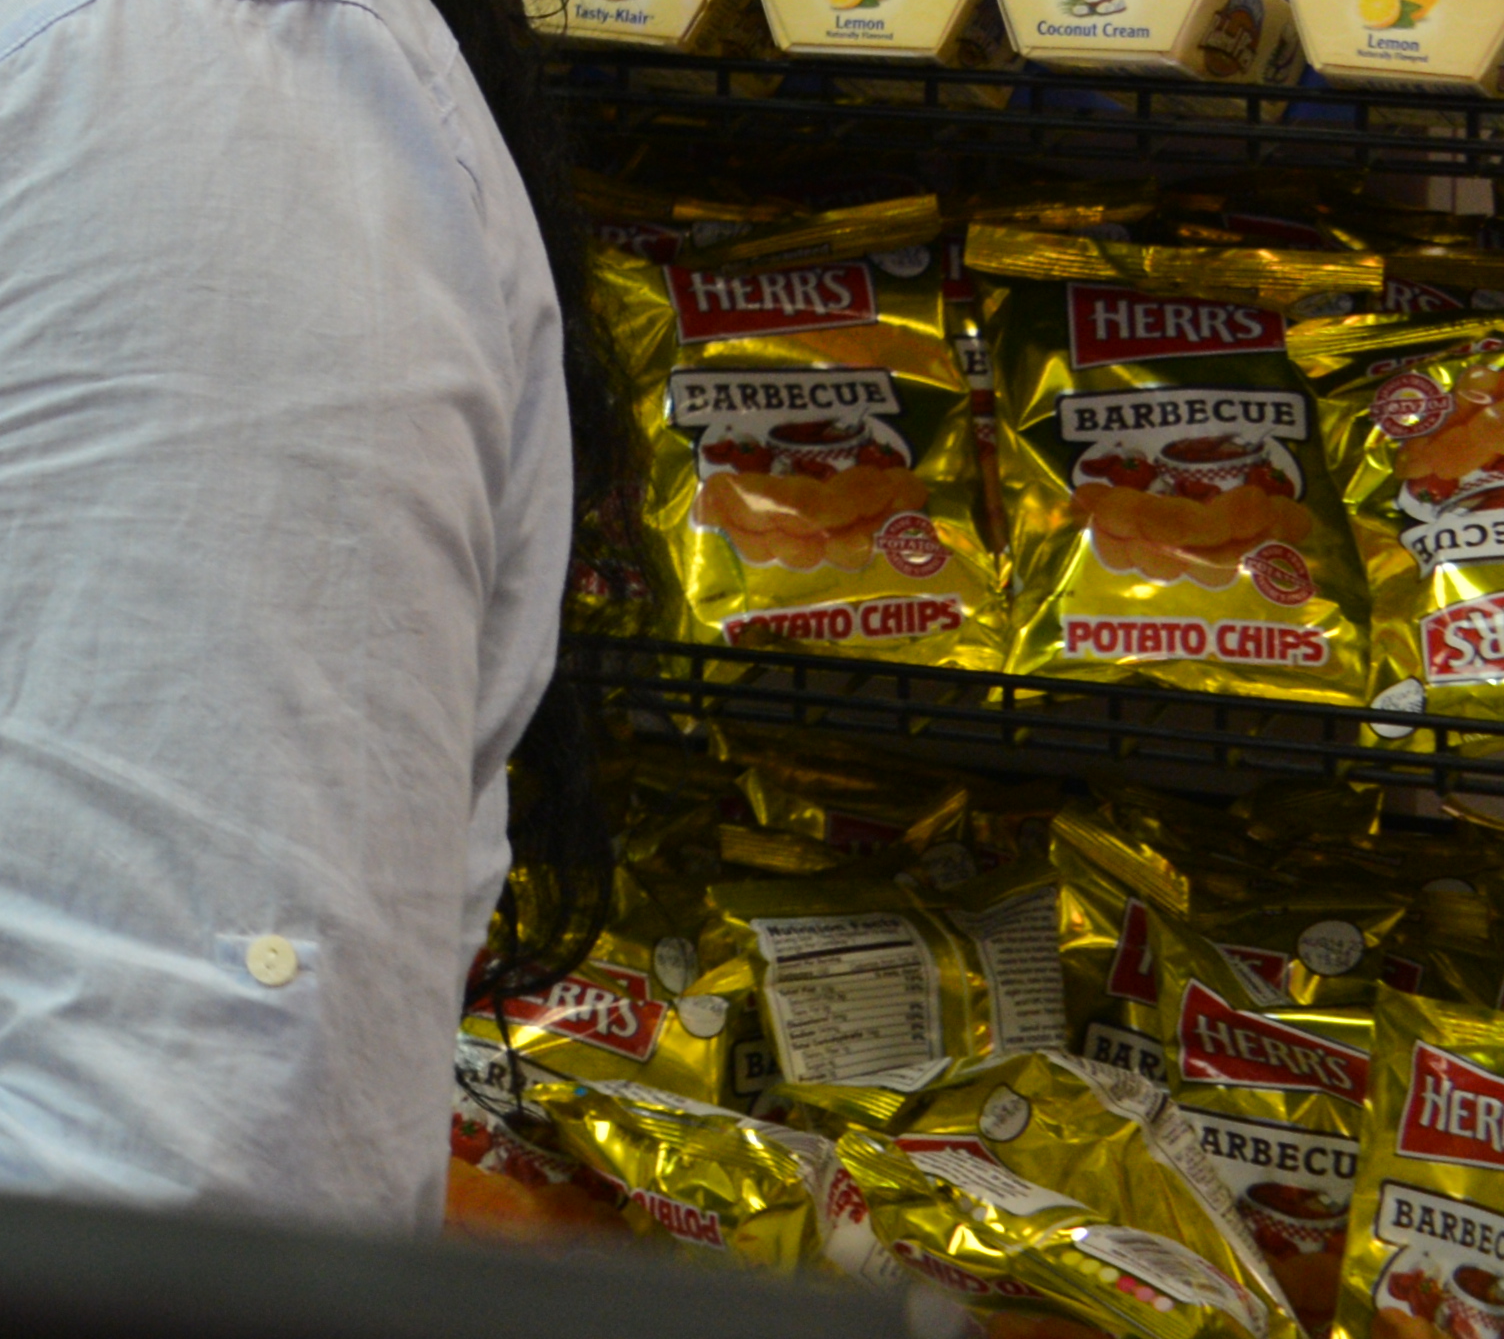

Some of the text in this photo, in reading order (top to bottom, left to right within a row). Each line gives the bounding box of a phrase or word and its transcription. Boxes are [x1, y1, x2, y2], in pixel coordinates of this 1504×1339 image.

[835, 14, 886, 32] Lemon
[1036, 20, 1152, 40] Coconut Cream
[1366, 33, 1421, 52] Lemon
[690, 267, 852, 317] HERR'S
[1090, 298, 1266, 343] HERR'S
[684, 381, 887, 413] BARBECUE
[1074, 398, 1297, 432] BARBECUE
[1414, 523, 1504, 563] ECUE
[860, 598, 963, 639] CHIPS
[1068, 621, 1326, 664] POTATO CHIPS
[1446, 611, 1504, 670] R'S
[1193, 1012, 1354, 1092] HERR'S
[1419, 1073, 1504, 1155] HER
[1200, 1125, 1359, 1181] ARBECU
[1393, 1197, 1504, 1261] BARBEC
